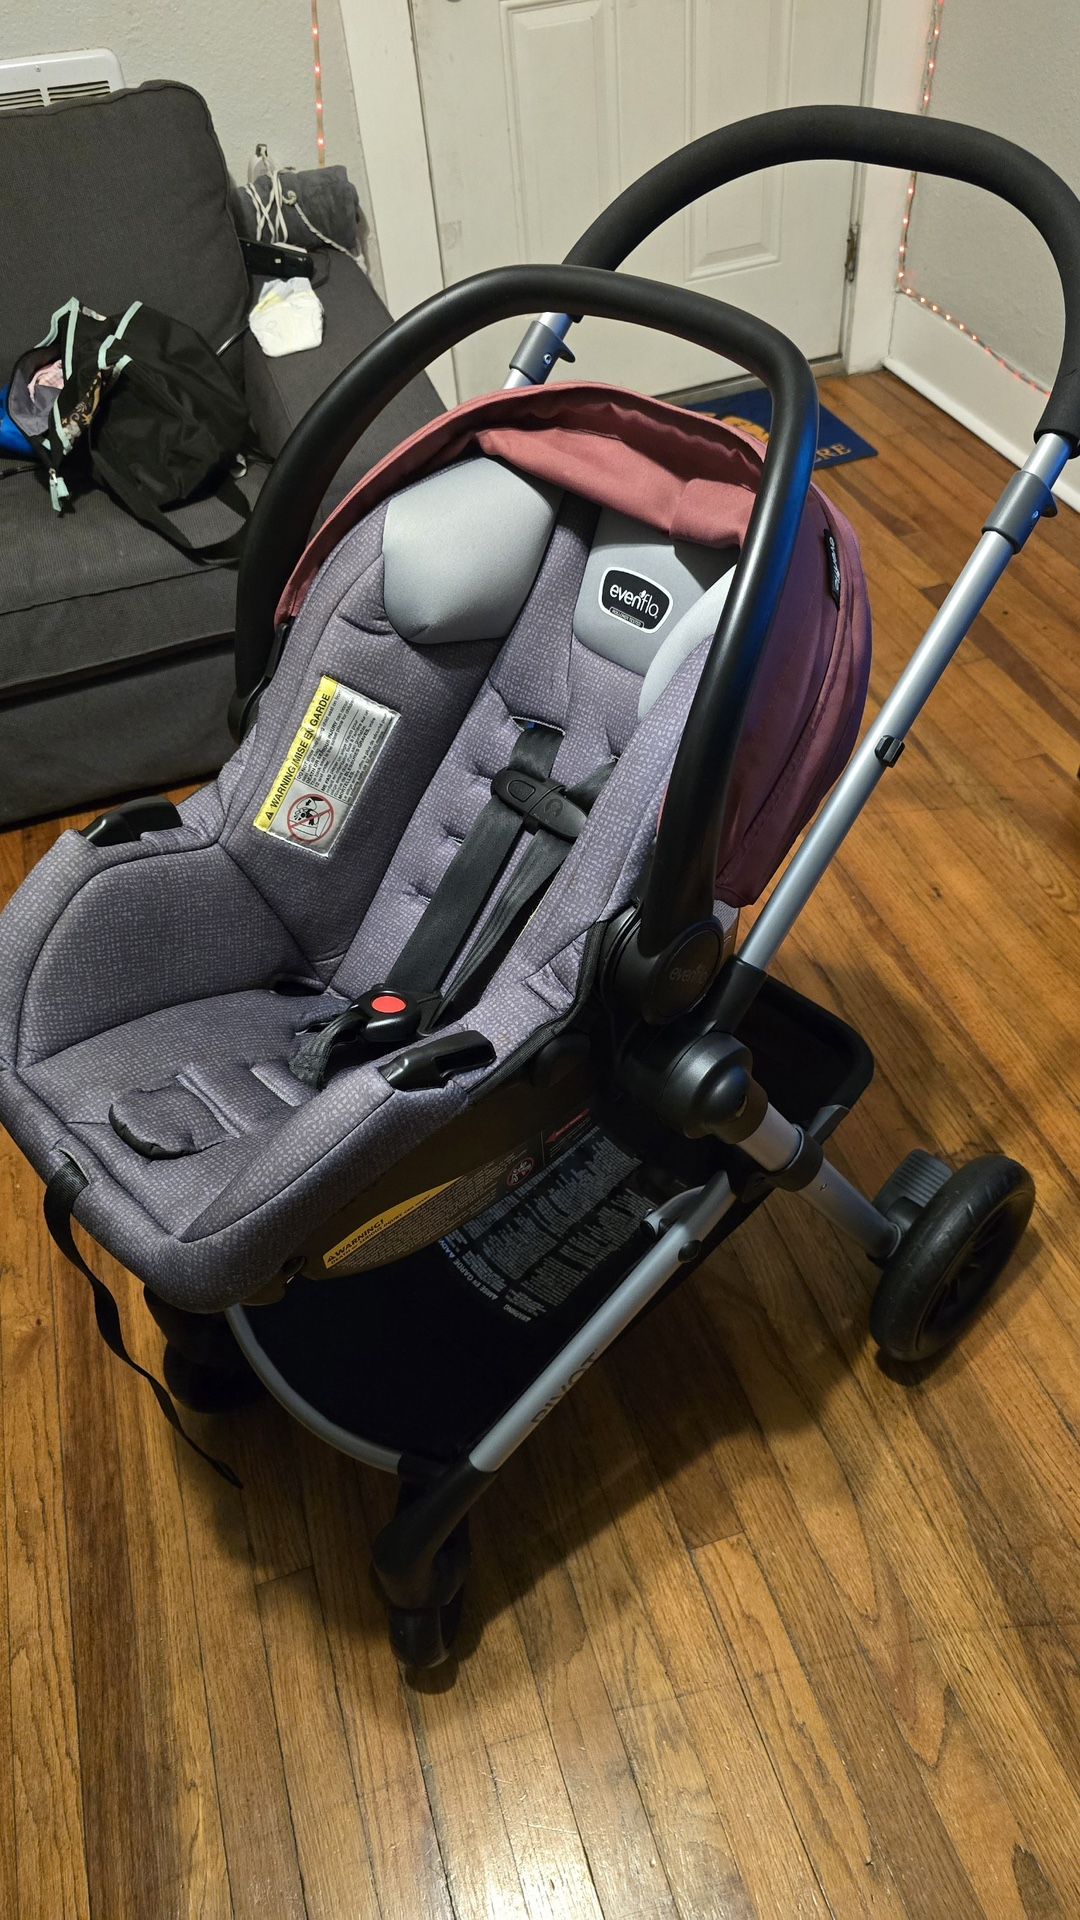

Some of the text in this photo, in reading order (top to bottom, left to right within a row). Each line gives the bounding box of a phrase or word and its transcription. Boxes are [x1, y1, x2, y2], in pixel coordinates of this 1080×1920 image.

[609, 584, 659, 617] evenflo
[304, 727, 315, 740] EN
[311, 693, 330, 727] GARDE
[451, 1257, 475, 1282] GARDE
